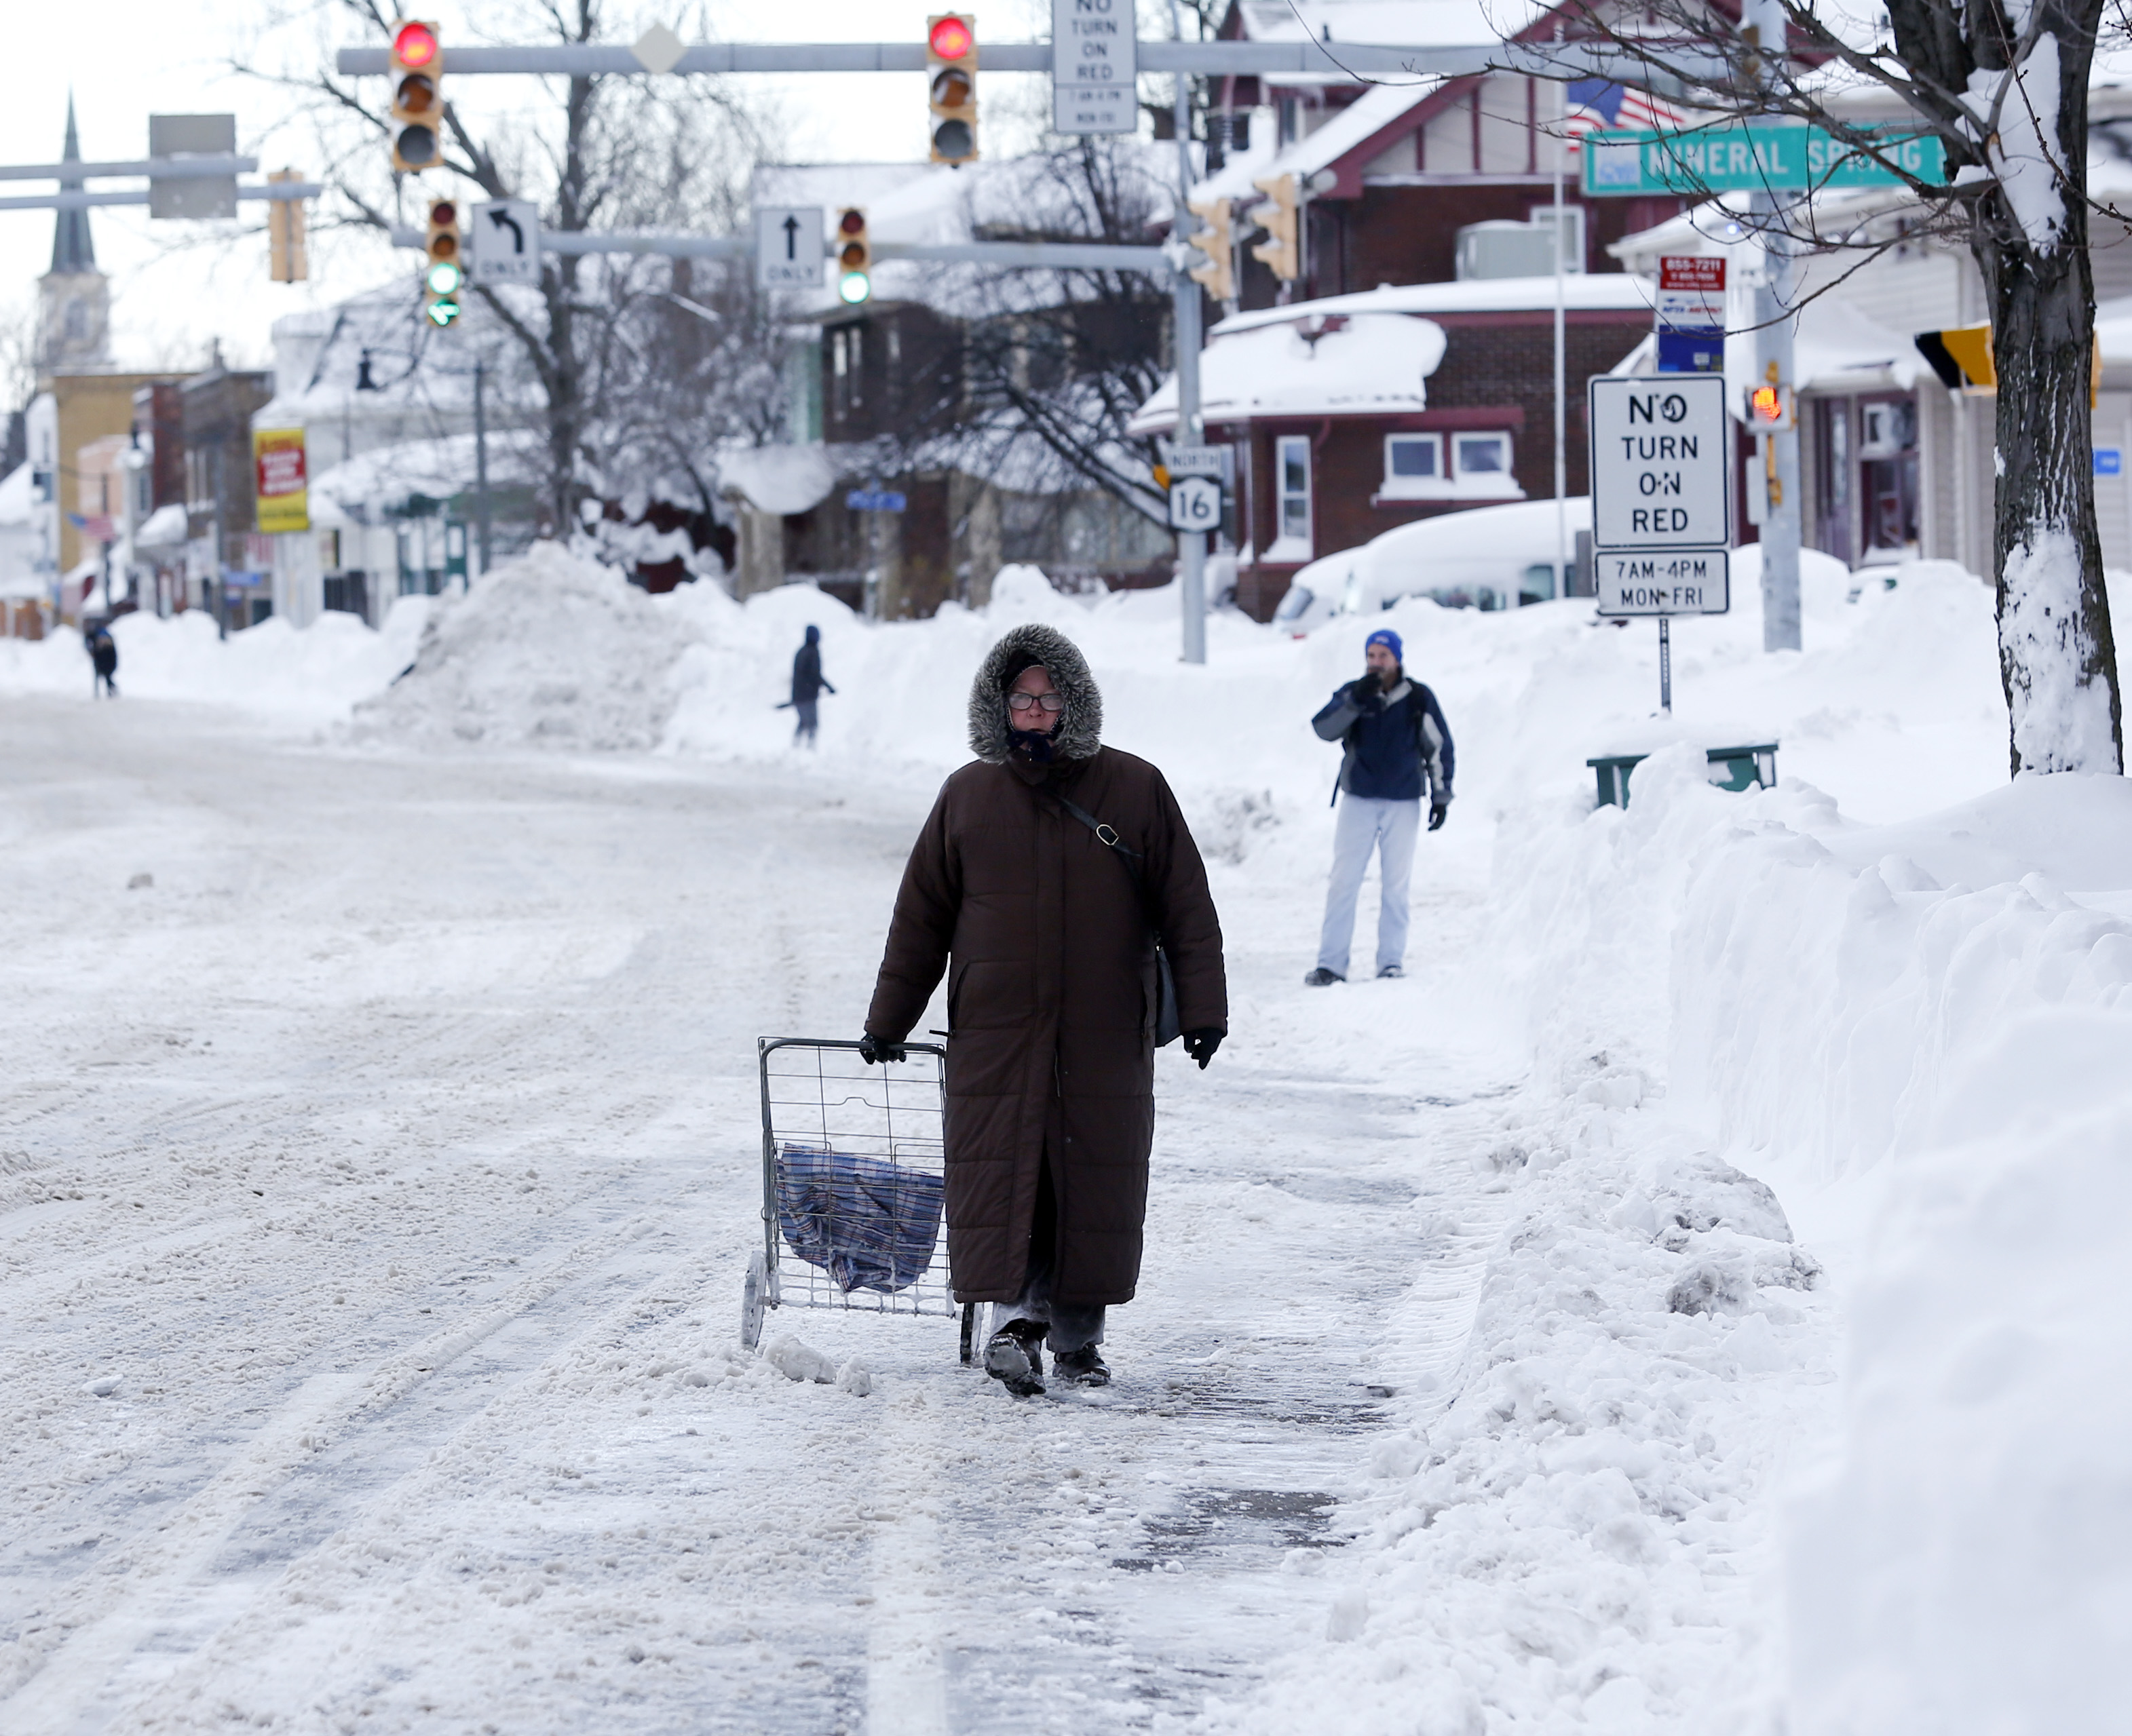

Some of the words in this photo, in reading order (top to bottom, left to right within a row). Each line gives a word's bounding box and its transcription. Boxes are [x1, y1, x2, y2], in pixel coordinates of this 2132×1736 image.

[1076, 0, 1111, 12] NO
[1071, 19, 1118, 35] TURN
[1083, 42, 1107, 56] ON
[1077, 64, 1113, 80] RED
[1649, 140, 1789, 176] MINERAL
[482, 261, 529, 275] ONLY
[767, 265, 816, 280] ONLY
[1630, 394, 1687, 423] NO
[1621, 436, 1698, 461] TURN
[1639, 471, 1681, 496] ON
[1179, 491, 1210, 519] 16
[1633, 508, 1688, 533] RED
[1616, 560, 1707, 579] 7AM-4PM
